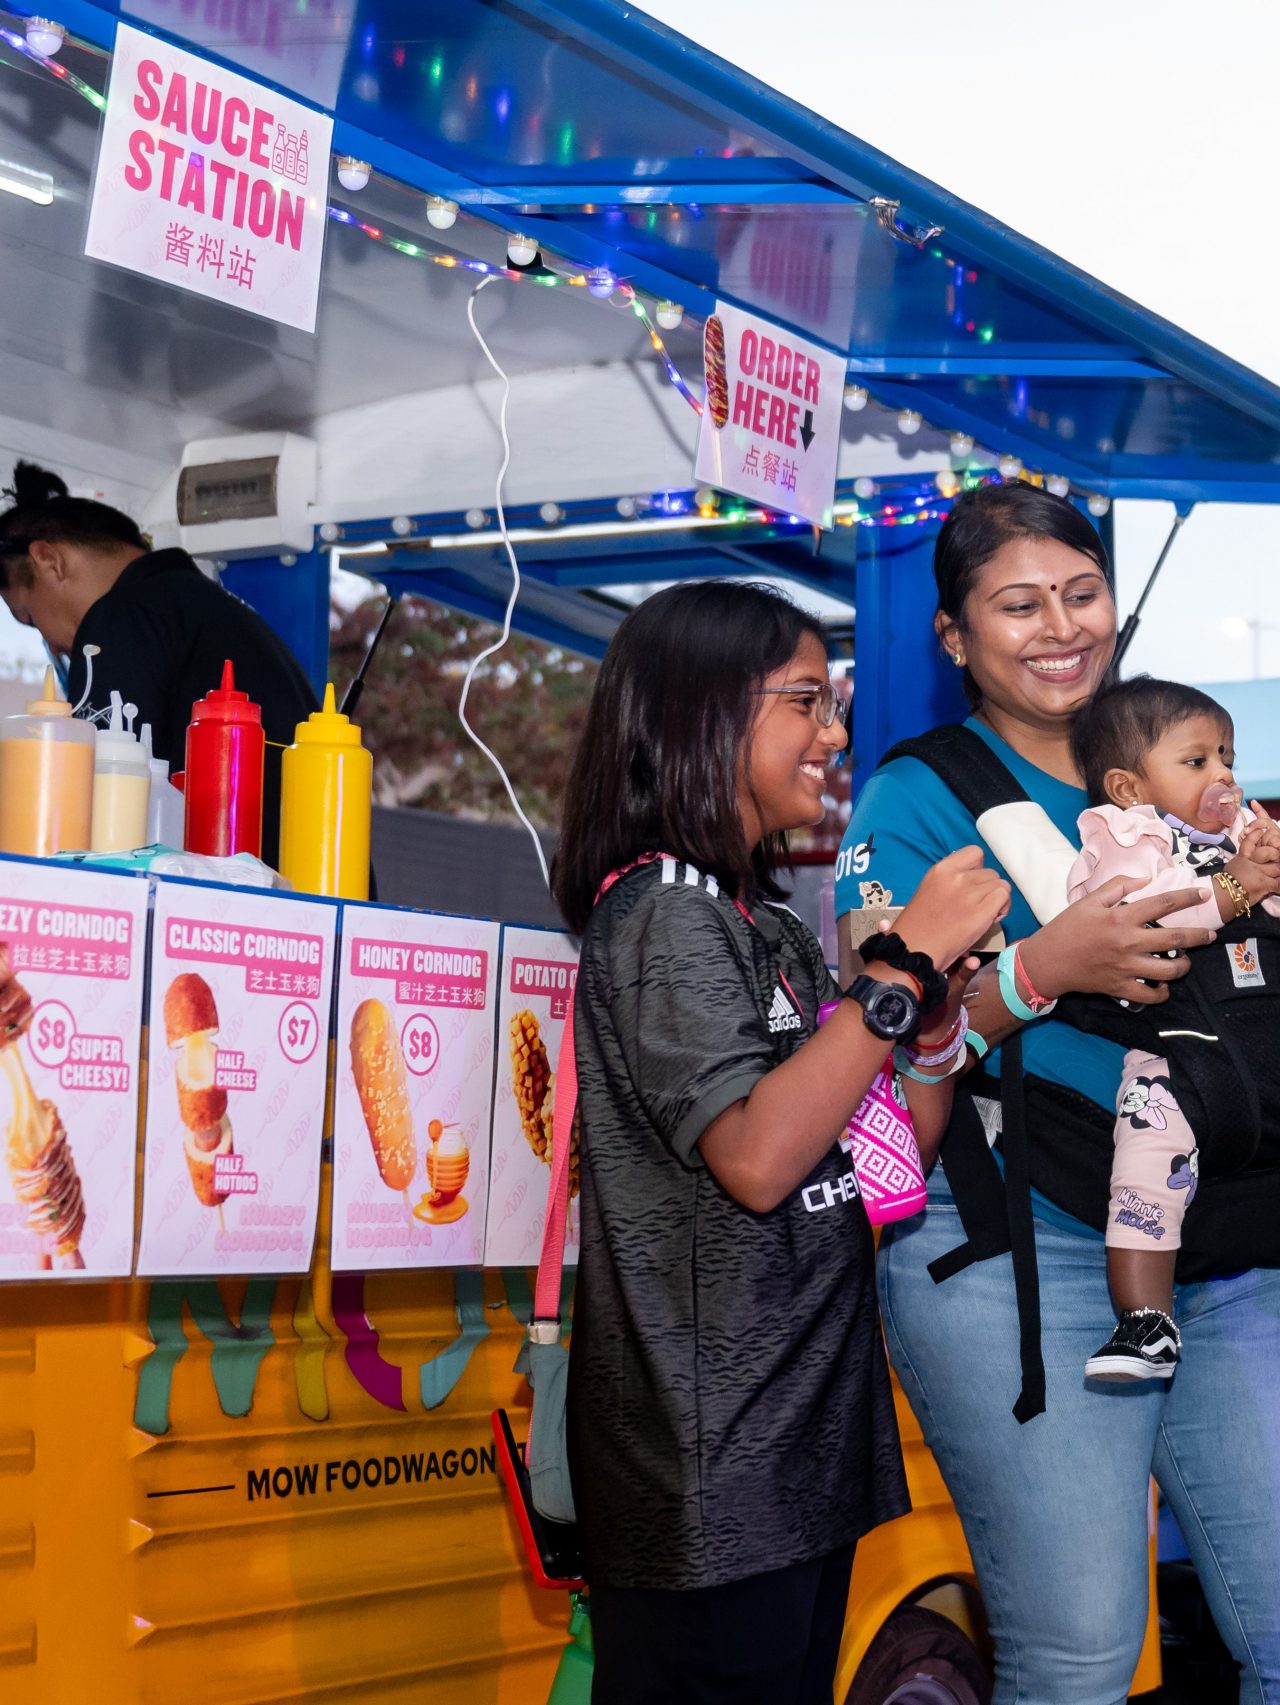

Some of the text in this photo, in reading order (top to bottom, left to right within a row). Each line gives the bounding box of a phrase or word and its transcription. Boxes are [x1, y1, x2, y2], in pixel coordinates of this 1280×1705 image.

[134, 59, 275, 170] SAUCE
[125, 129, 305, 251] STATION
[165, 222, 257, 290] 酱料站
[739, 329, 820, 406] ORDER
[733, 380, 800, 448] HERE
[742, 444, 799, 493] 点餐站
[37, 908, 129, 943] CORNDOG
[169, 923, 320, 964] CLASSIC CORNDOG
[13, 944, 129, 977] 拉丝芝士玉米狗
[359, 944, 482, 978] HONEY CORNDOG
[515, 963, 567, 989] POTATO
[250, 969, 320, 996] 芝士玉米狗
[399, 981, 485, 1006] 蜜汁芝士玉米狗
[38, 1016, 66, 1051] $8
[287, 1016, 310, 1047] $7
[768, 1013, 801, 1033] adidas
[71, 1038, 121, 1062] SUPER
[409, 1028, 432, 1060] $8
[62, 1063, 129, 1089] CHEESY!
[217, 1053, 243, 1069] HALF
[216, 1071, 256, 1089] CHEESE
[216, 1156, 242, 1173] HALF
[215, 1175, 257, 1191] HOTDOG
[1117, 1187, 1164, 1221] Minnie
[247, 1464, 319, 1501] MOW
[325, 1445, 496, 1493] FOODWAGON
